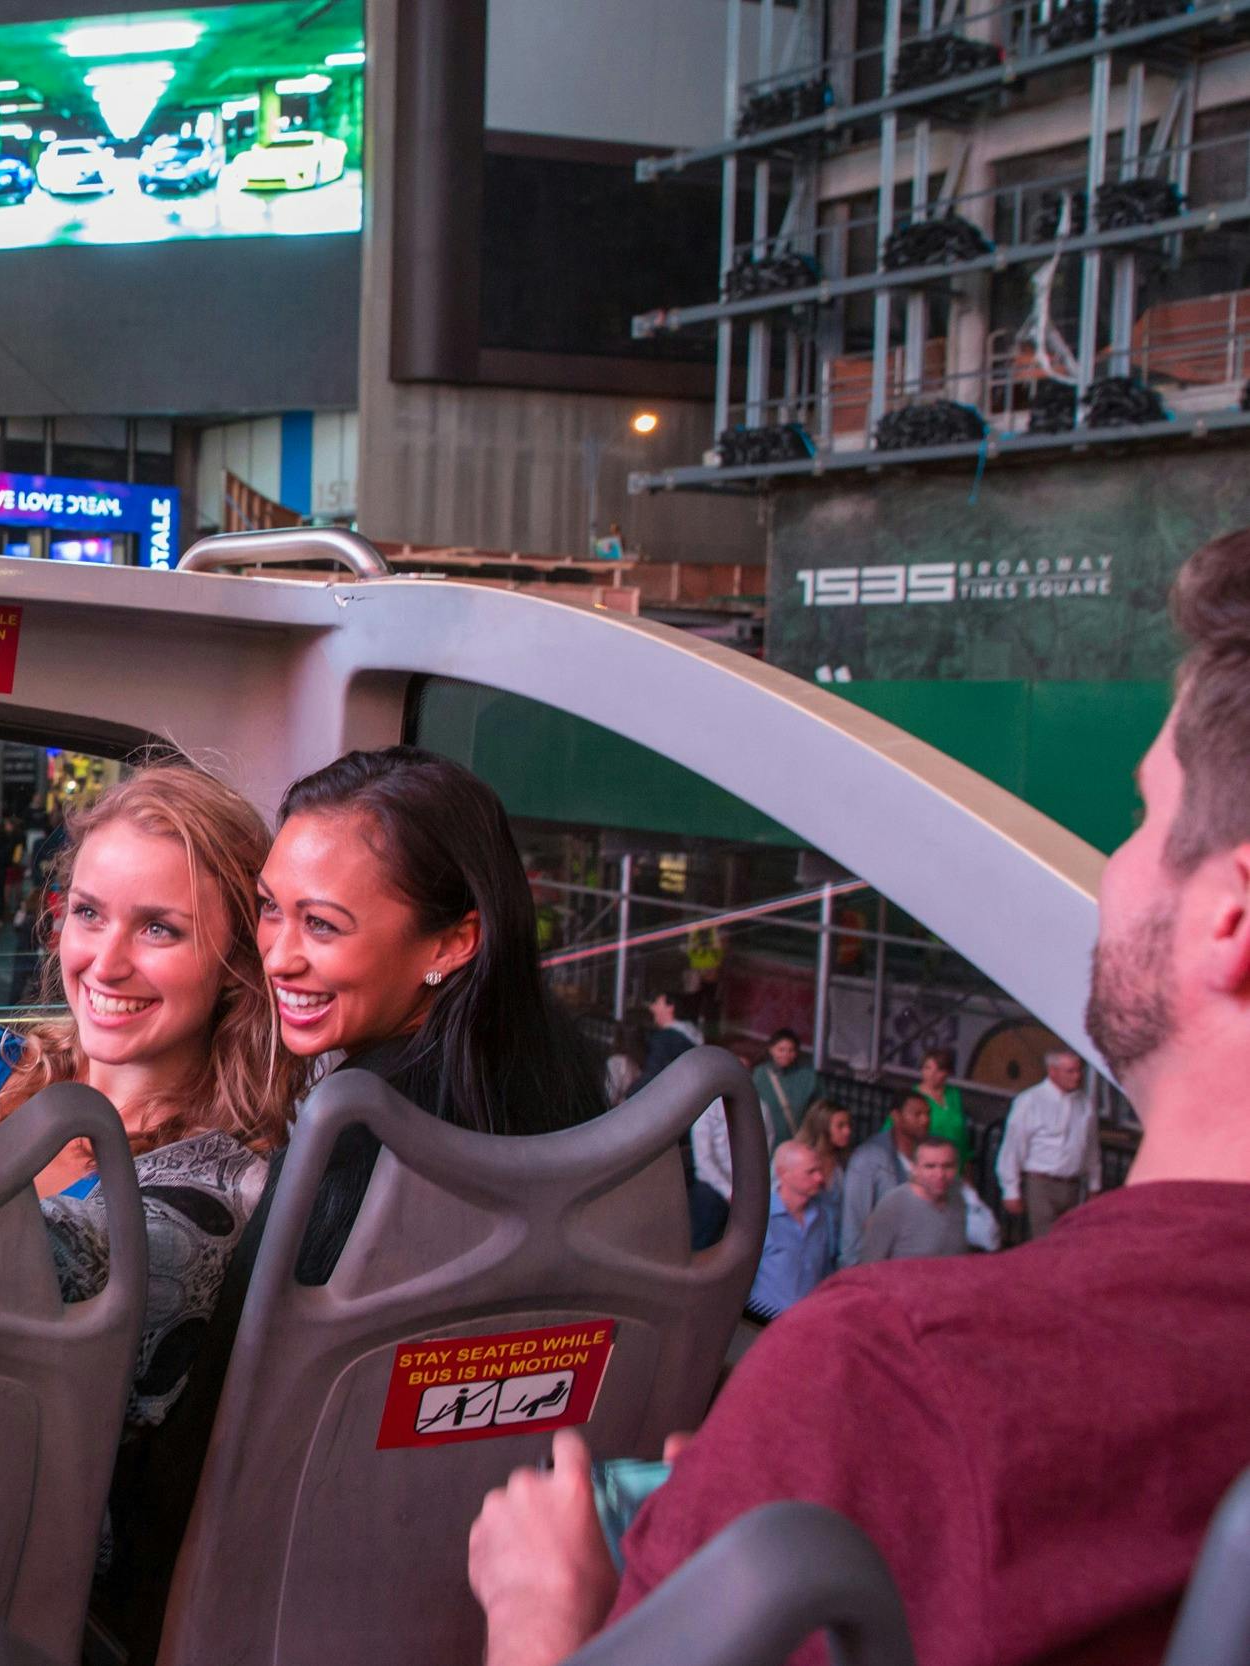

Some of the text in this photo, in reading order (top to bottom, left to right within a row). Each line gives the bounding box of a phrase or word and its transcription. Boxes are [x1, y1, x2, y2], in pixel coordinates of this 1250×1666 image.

[18, 490, 64, 513] LOVE
[959, 555, 1113, 578] BROADWAY
[796, 562, 956, 607] 1535
[960, 575, 1112, 599] TIMES SQUARE
[399, 1330, 607, 1368] STAY SEATED WHILE
[408, 1351, 589, 1386] BUS IS IN MOTION
